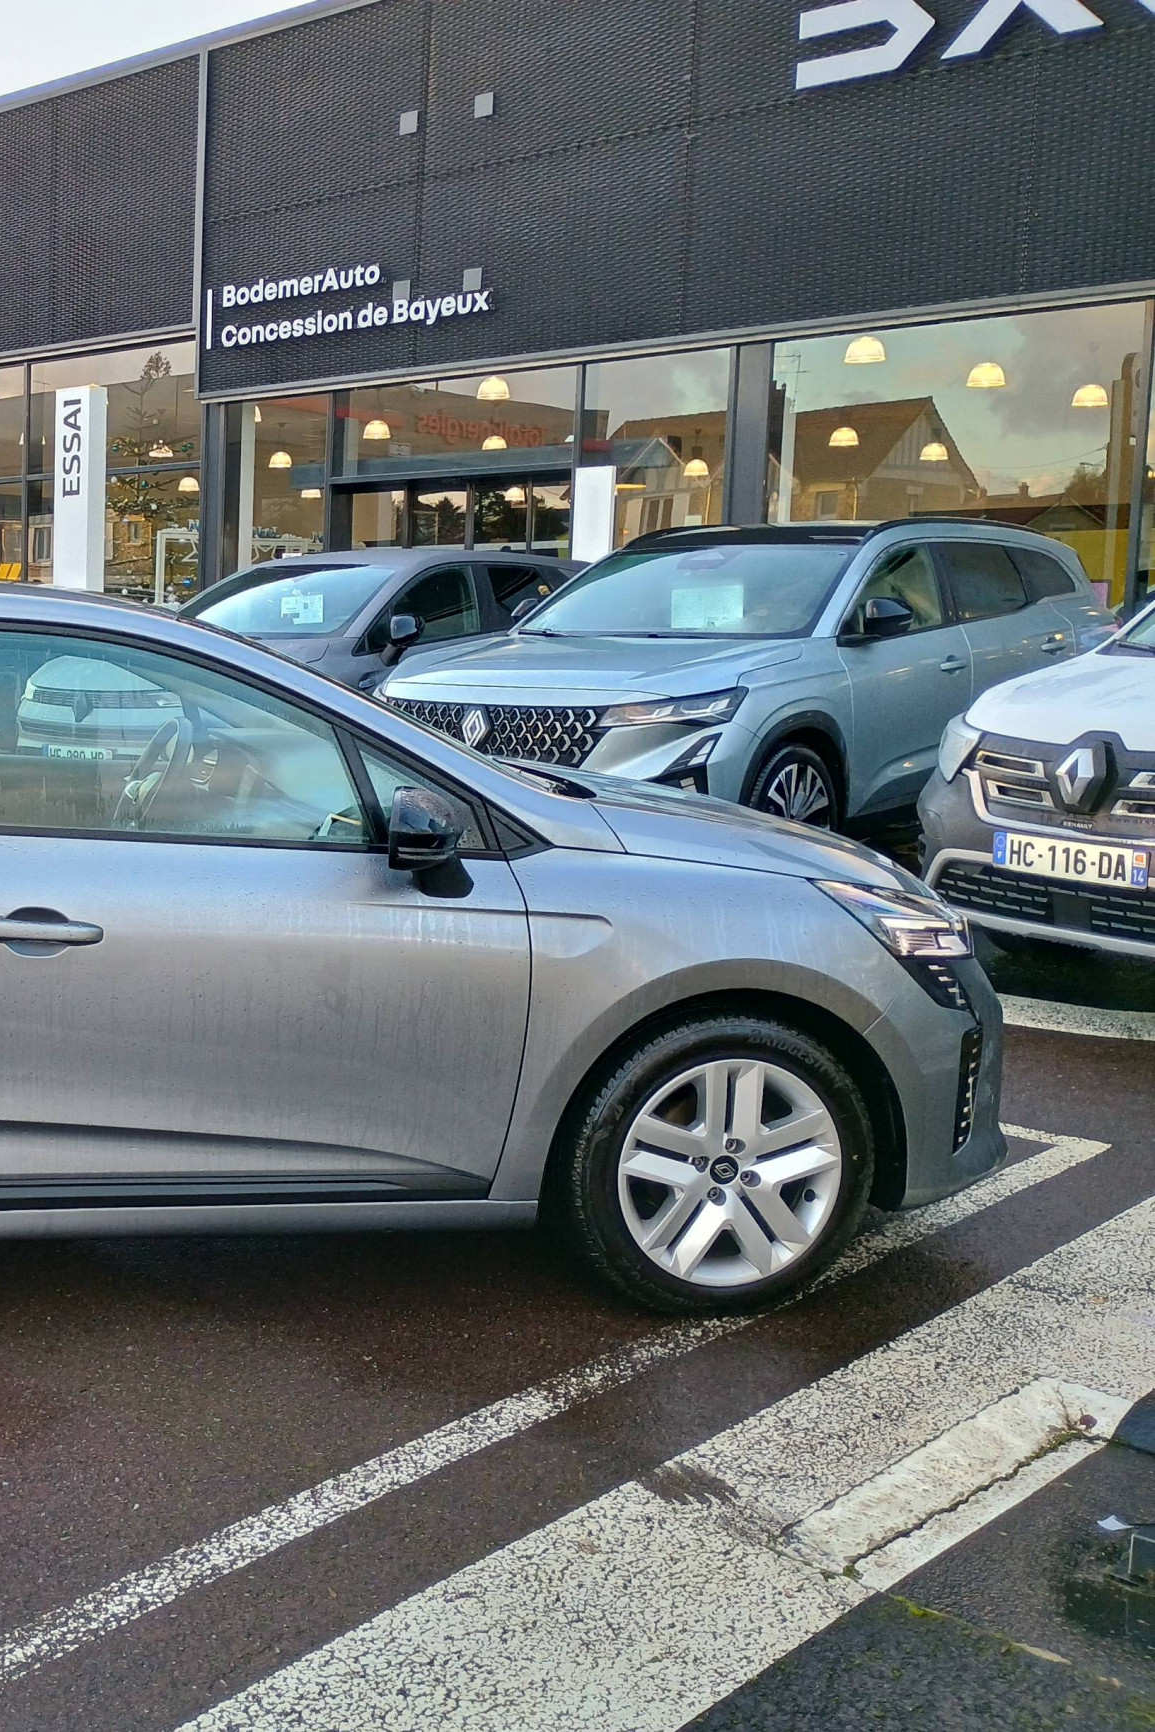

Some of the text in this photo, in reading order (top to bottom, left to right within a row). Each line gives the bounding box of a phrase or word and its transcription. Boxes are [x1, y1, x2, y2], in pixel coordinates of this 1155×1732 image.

[222, 263, 381, 308] BodemerAuto
[221, 290, 490, 348] Concession de Bayeux
[62, 398, 81, 498] ESSAI
[1009, 839, 1127, 882] HC-116-DA
[1132, 869, 1145, 883] 14
